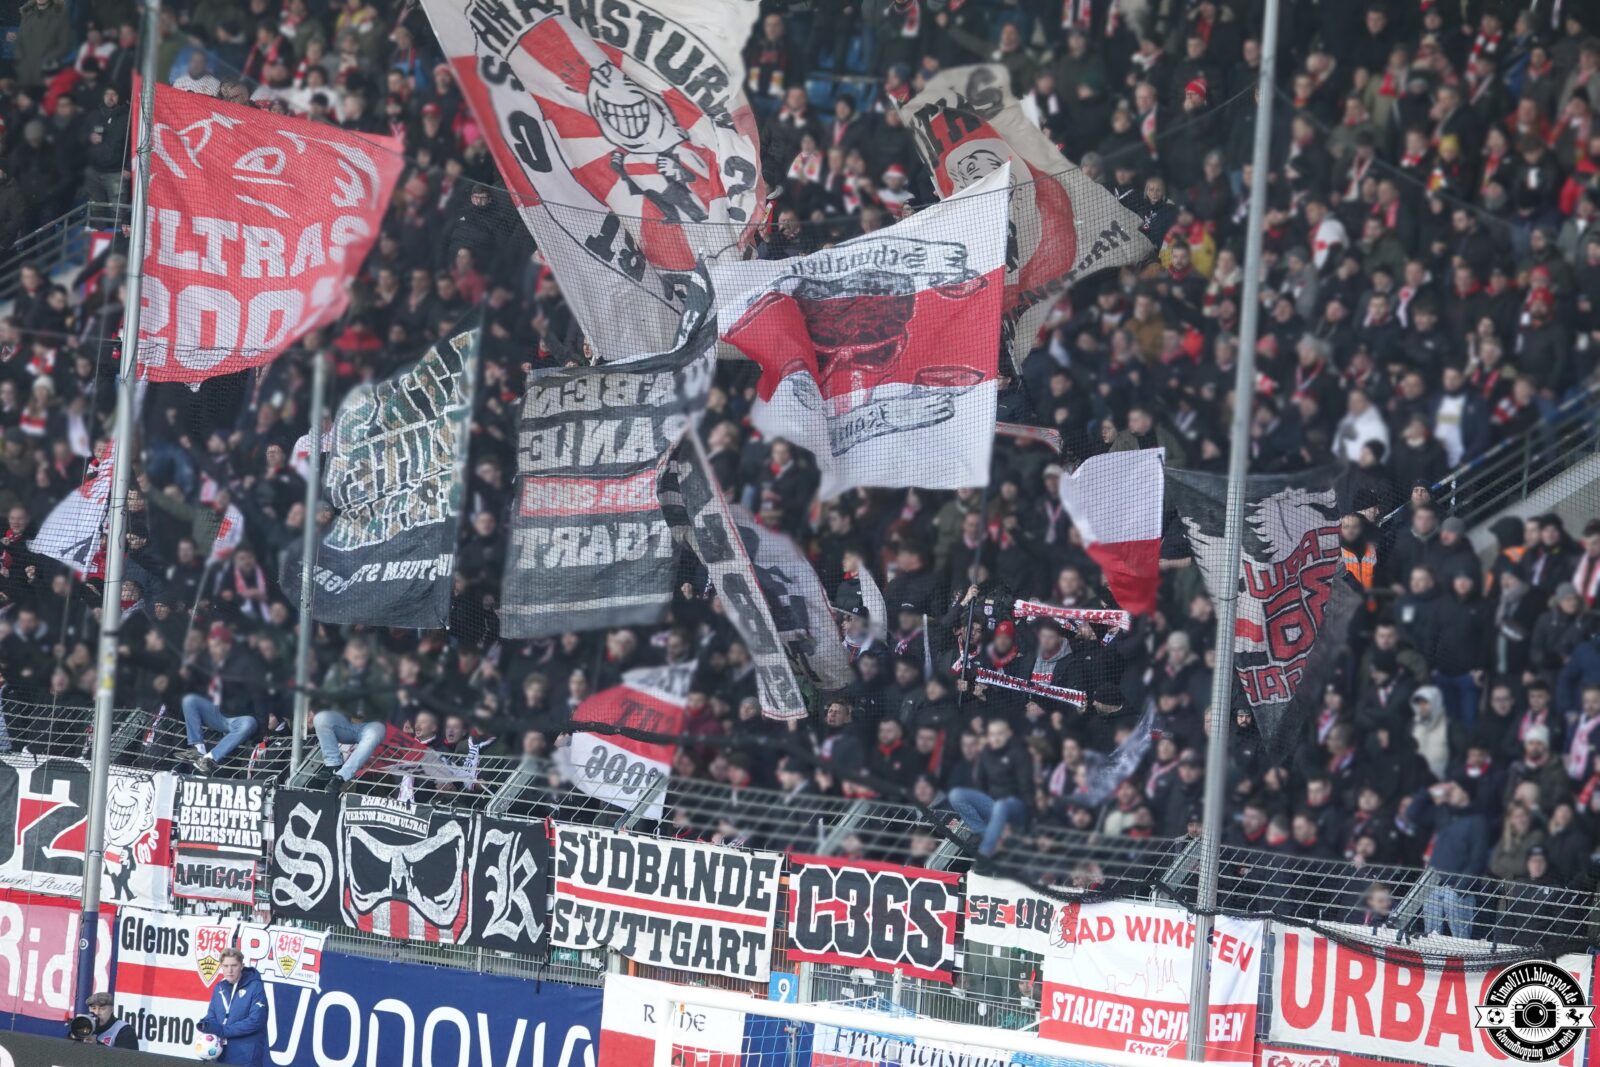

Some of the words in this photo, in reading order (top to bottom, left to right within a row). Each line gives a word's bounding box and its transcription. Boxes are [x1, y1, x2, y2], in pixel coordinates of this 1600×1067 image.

[180, 806, 261, 831] BEDEUTET
[182, 782, 262, 812] ULTRAS
[179, 826, 262, 848] WIDERSTAND
[33, 876, 83, 895] Stuttg
[556, 829, 776, 913] SÜDBANDE
[121, 914, 189, 958] Glems
[552, 899, 767, 977] STUTTGART
[795, 863, 950, 972] C36S
[777, 978, 791, 1004] 9
[1280, 932, 1580, 1067] URBA
[117, 1004, 195, 1046] Inferno
[1051, 991, 1135, 1035] STAUFER
[1140, 1007, 1247, 1043] SCHBEN
